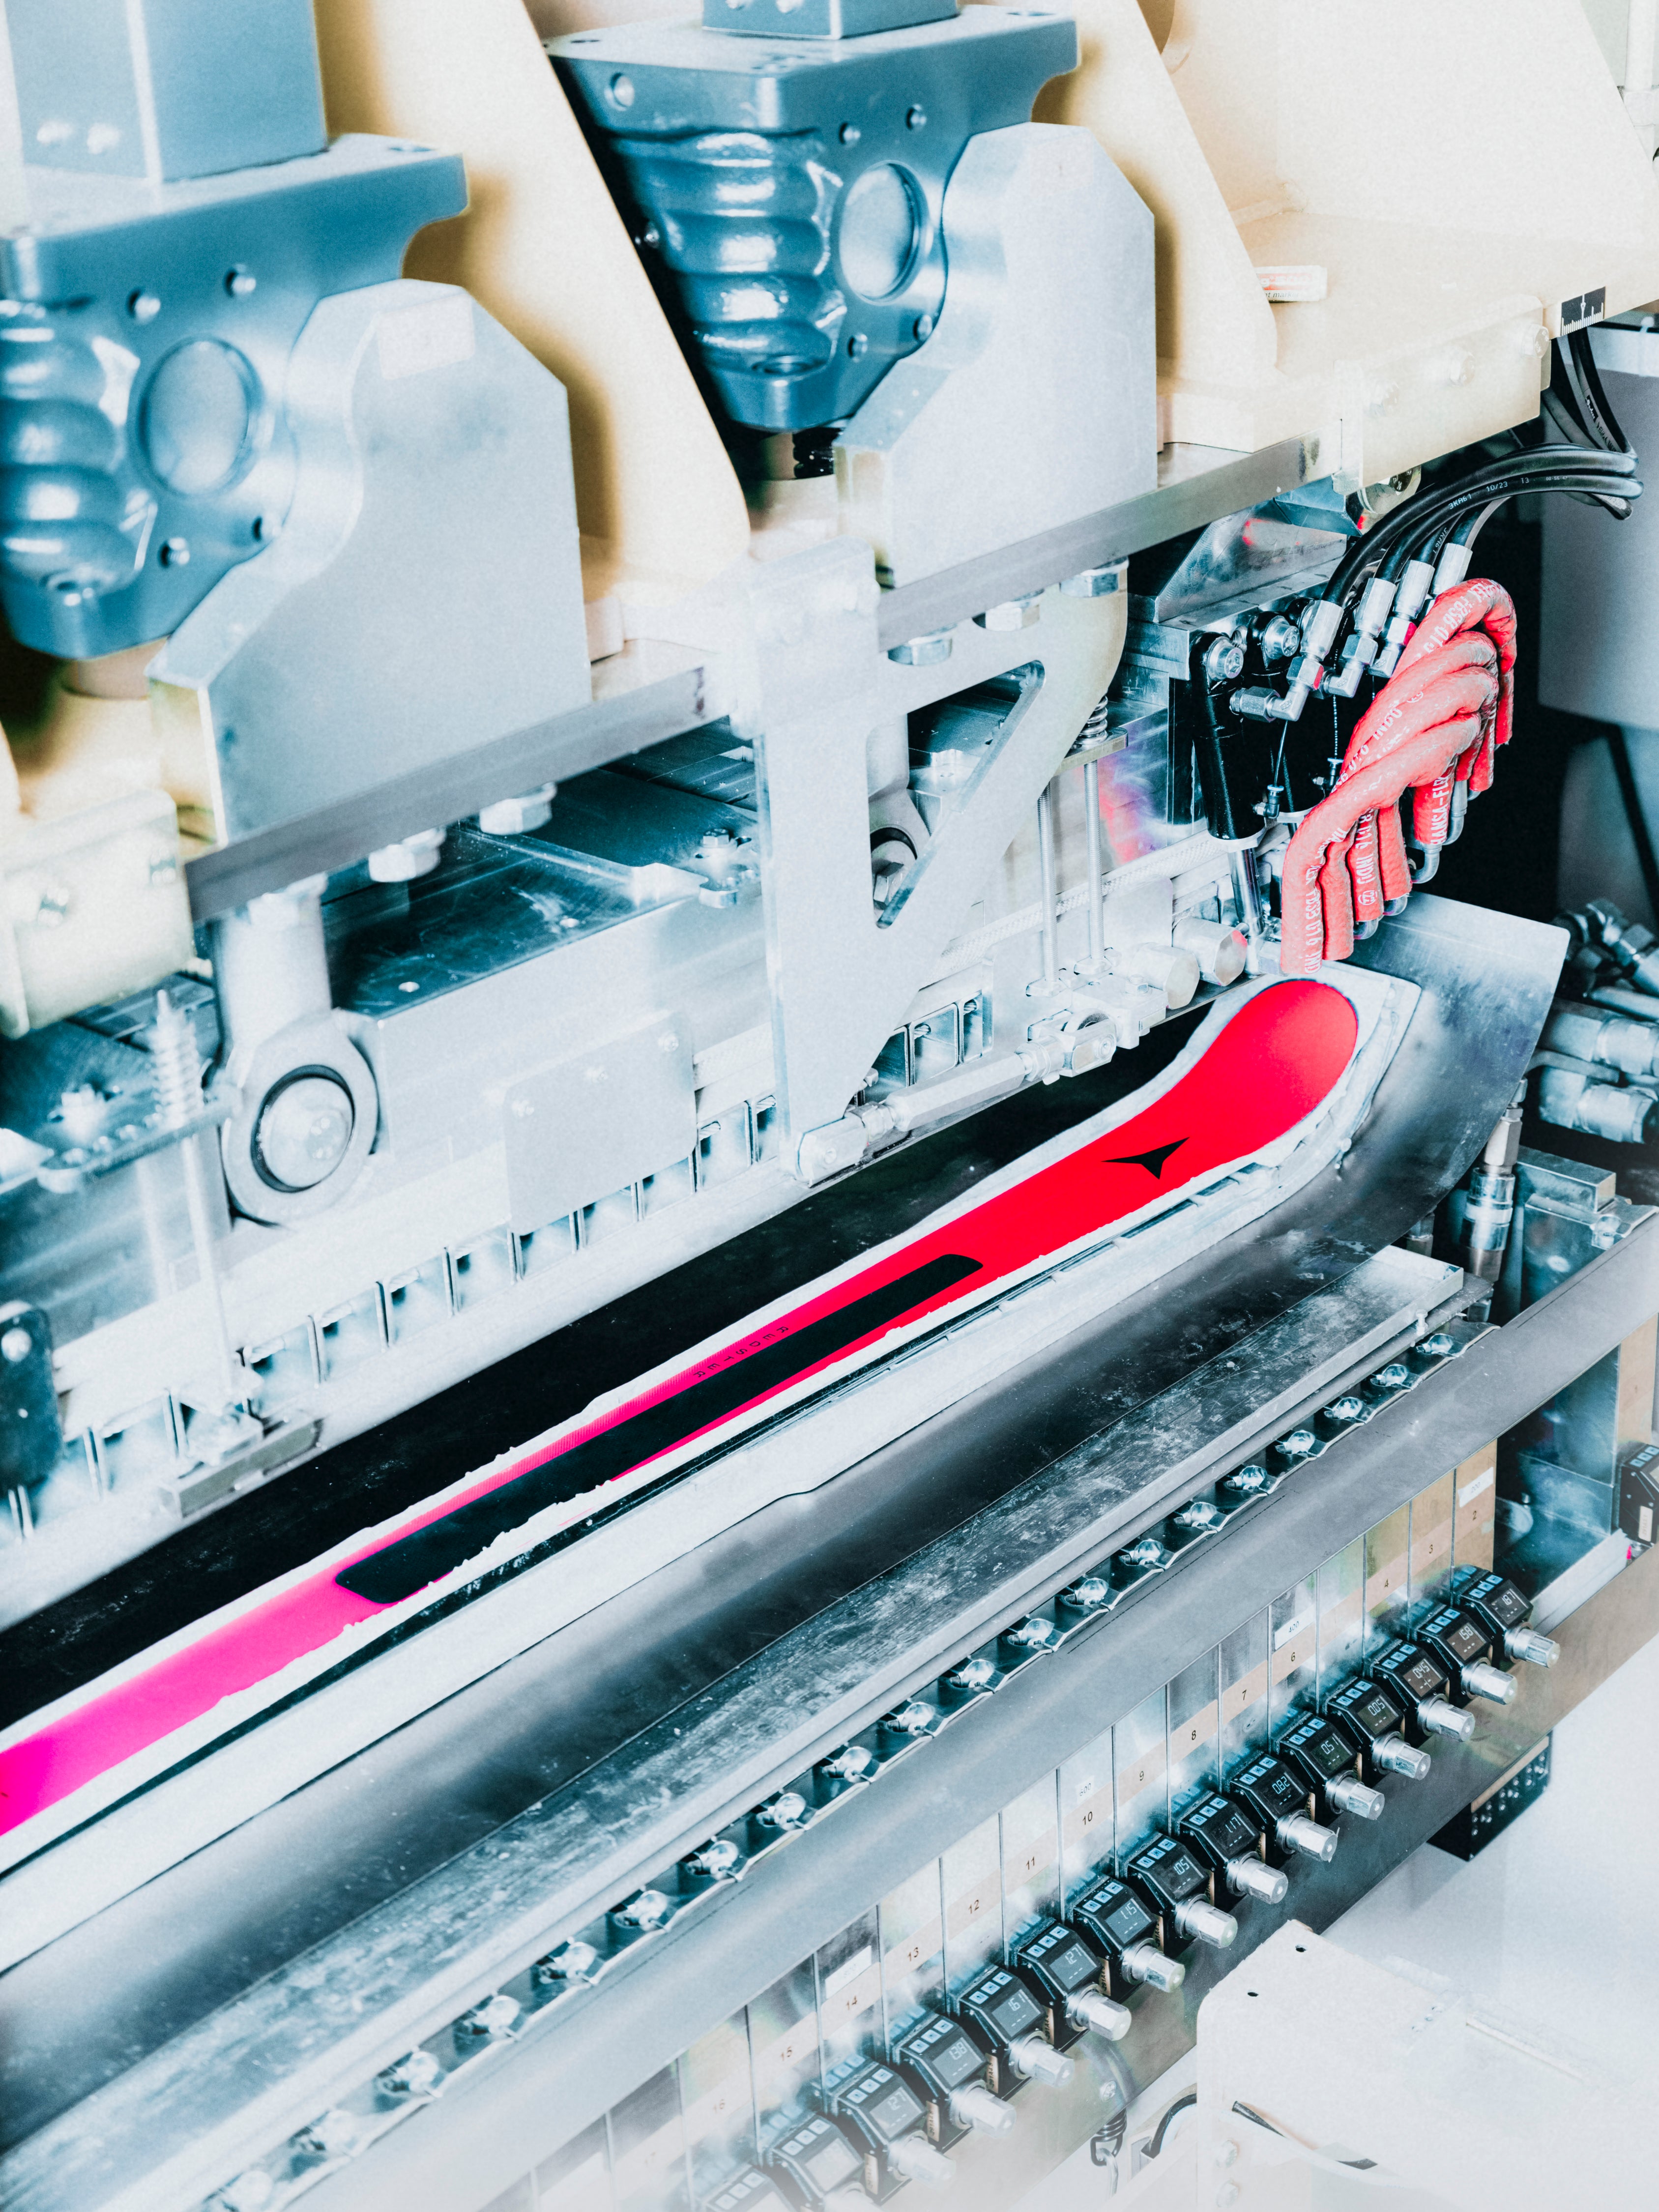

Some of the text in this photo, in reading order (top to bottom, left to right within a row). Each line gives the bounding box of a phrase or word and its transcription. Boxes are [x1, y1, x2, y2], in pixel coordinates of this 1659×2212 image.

[1485, 481, 1508, 492] 10/23
[693, 1326, 789, 1378] REDSTER
[1472, 1510, 1477, 1521] 2
[1428, 1544, 1433, 1554] 3
[1384, 1578, 1389, 1588] 4
[1290, 1652, 1296, 1662] 6
[1242, 1689, 1247, 1701] 7
[1191, 1730, 1196, 1741] 8
[1139, 1771, 1144, 1781] 9
[1082, 1811, 1093, 1826] 10
[1025, 1856, 1035, 1870] 11
[968, 1899, 980, 1914] 12
[907, 1947, 919, 1962] 13
[845, 1995, 858, 2010] 14
[780, 2045, 792, 2061] 15
[713, 2098, 726, 2114] 16
